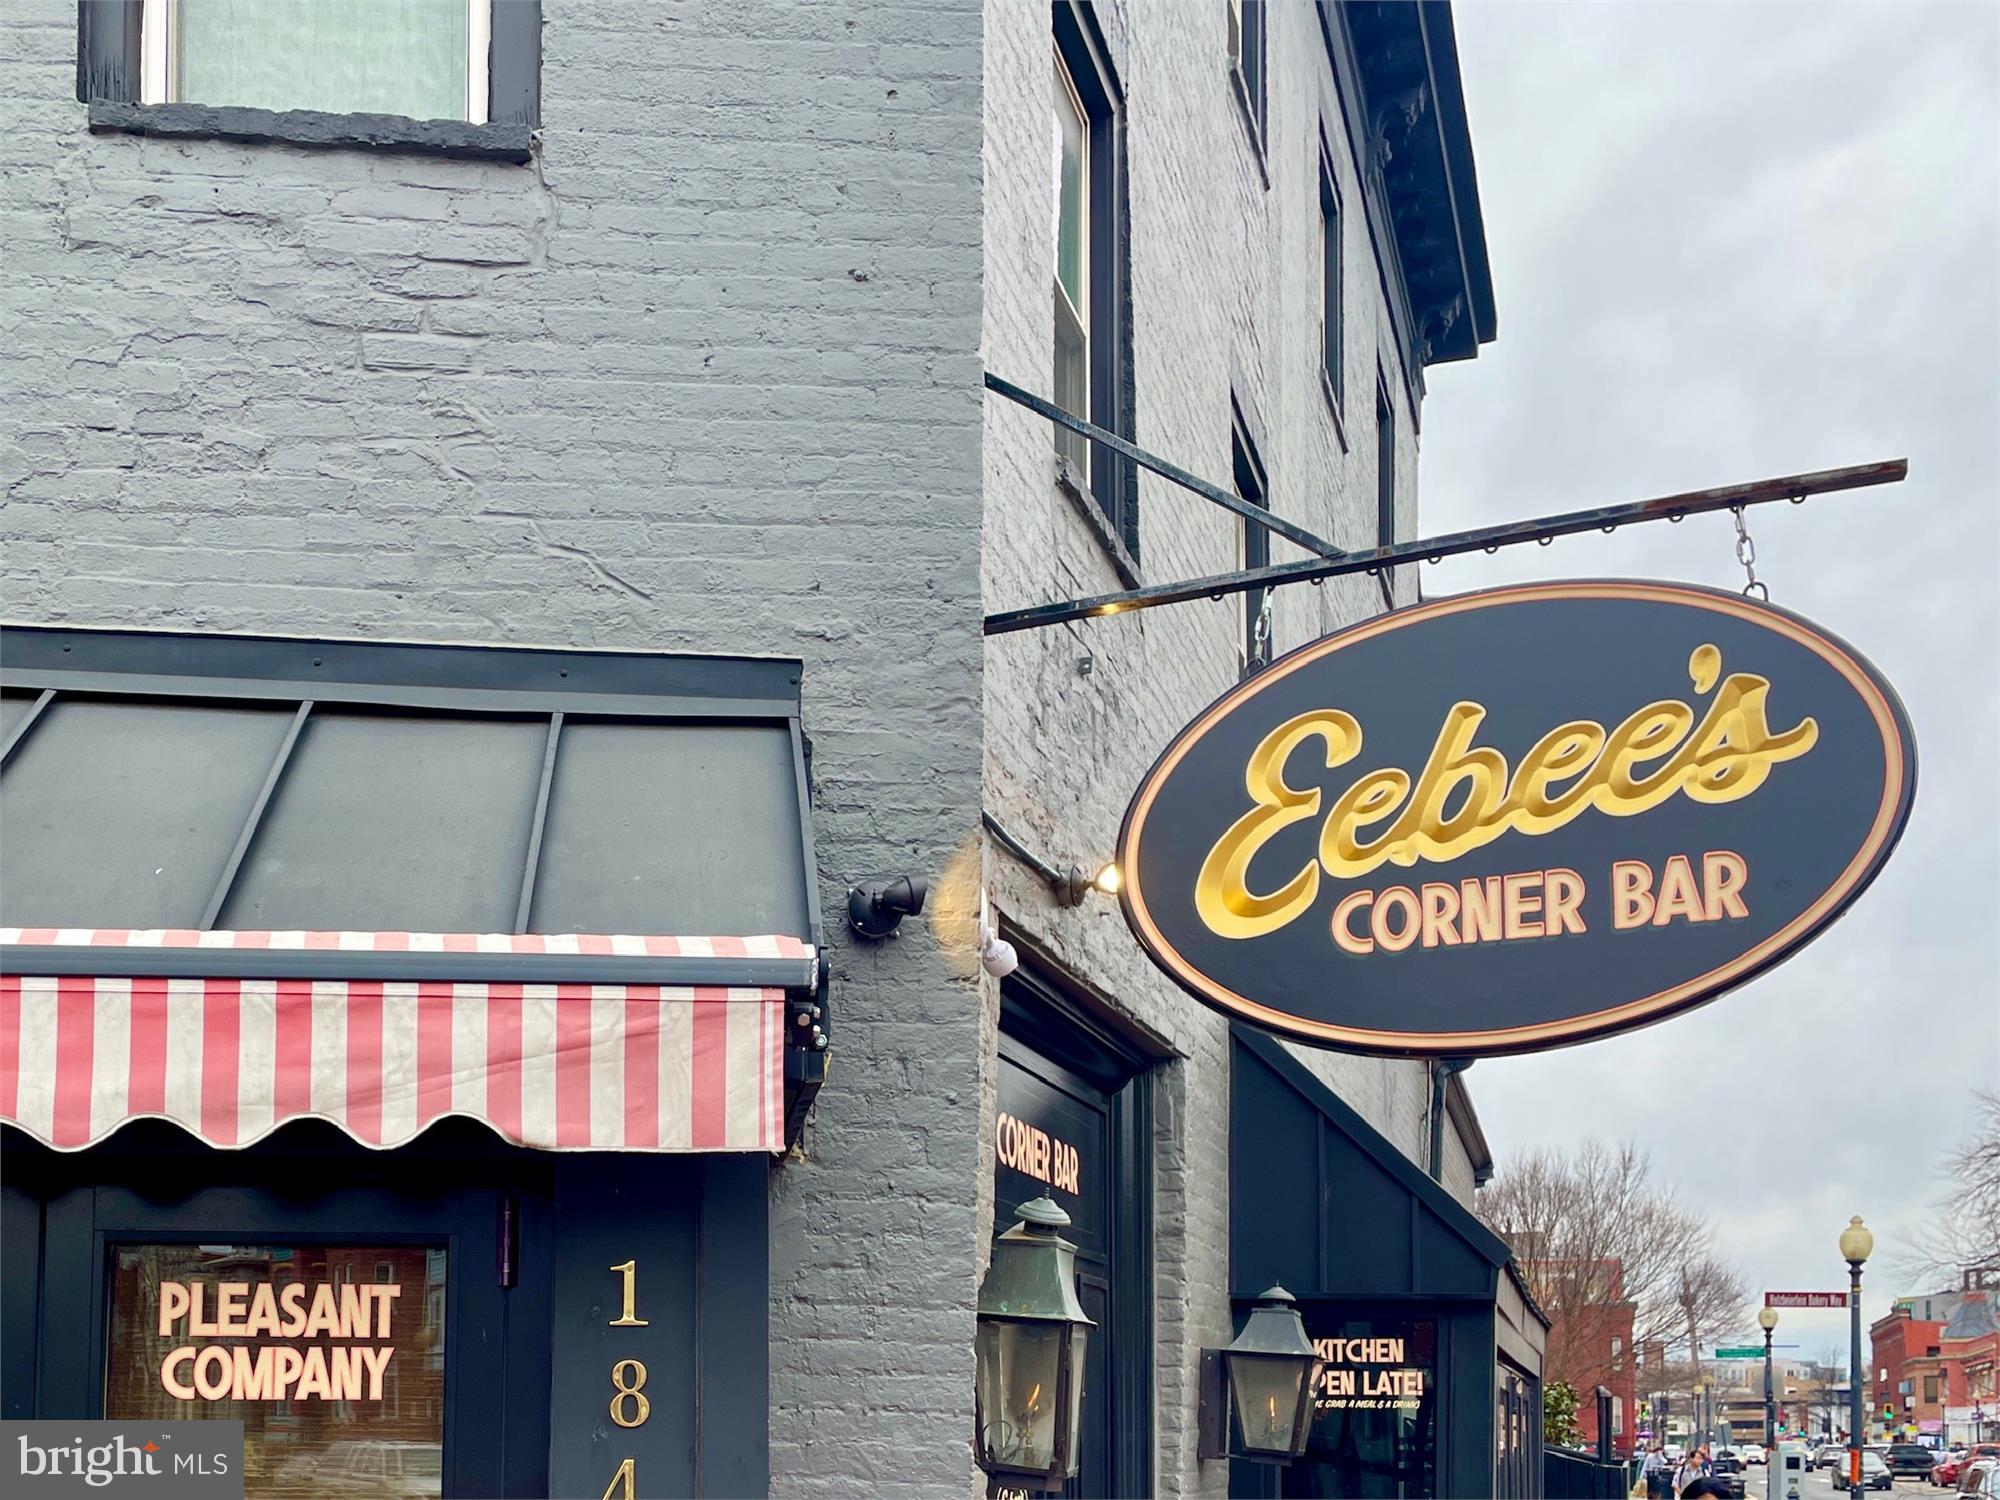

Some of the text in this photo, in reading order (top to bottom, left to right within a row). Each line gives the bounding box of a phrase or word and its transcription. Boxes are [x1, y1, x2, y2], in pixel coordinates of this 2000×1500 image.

[1194, 643, 1820, 940] Eebee's
[1330, 850, 1750, 955] CORNER BAR
[996, 1111, 1079, 1195] CORNER BAR
[159, 1281, 401, 1339] PLEASANT
[160, 1345, 395, 1402] COMPANY
[1313, 1338, 1404, 1363] KITCHEN
[1325, 1399, 1346, 1409] GRAB
[1348, 1399, 1355, 1408] A
[1355, 1399, 1376, 1409] MEAL
[1385, 1400, 1392, 1409] A
[1363, 1370, 1423, 1396] LATE!
